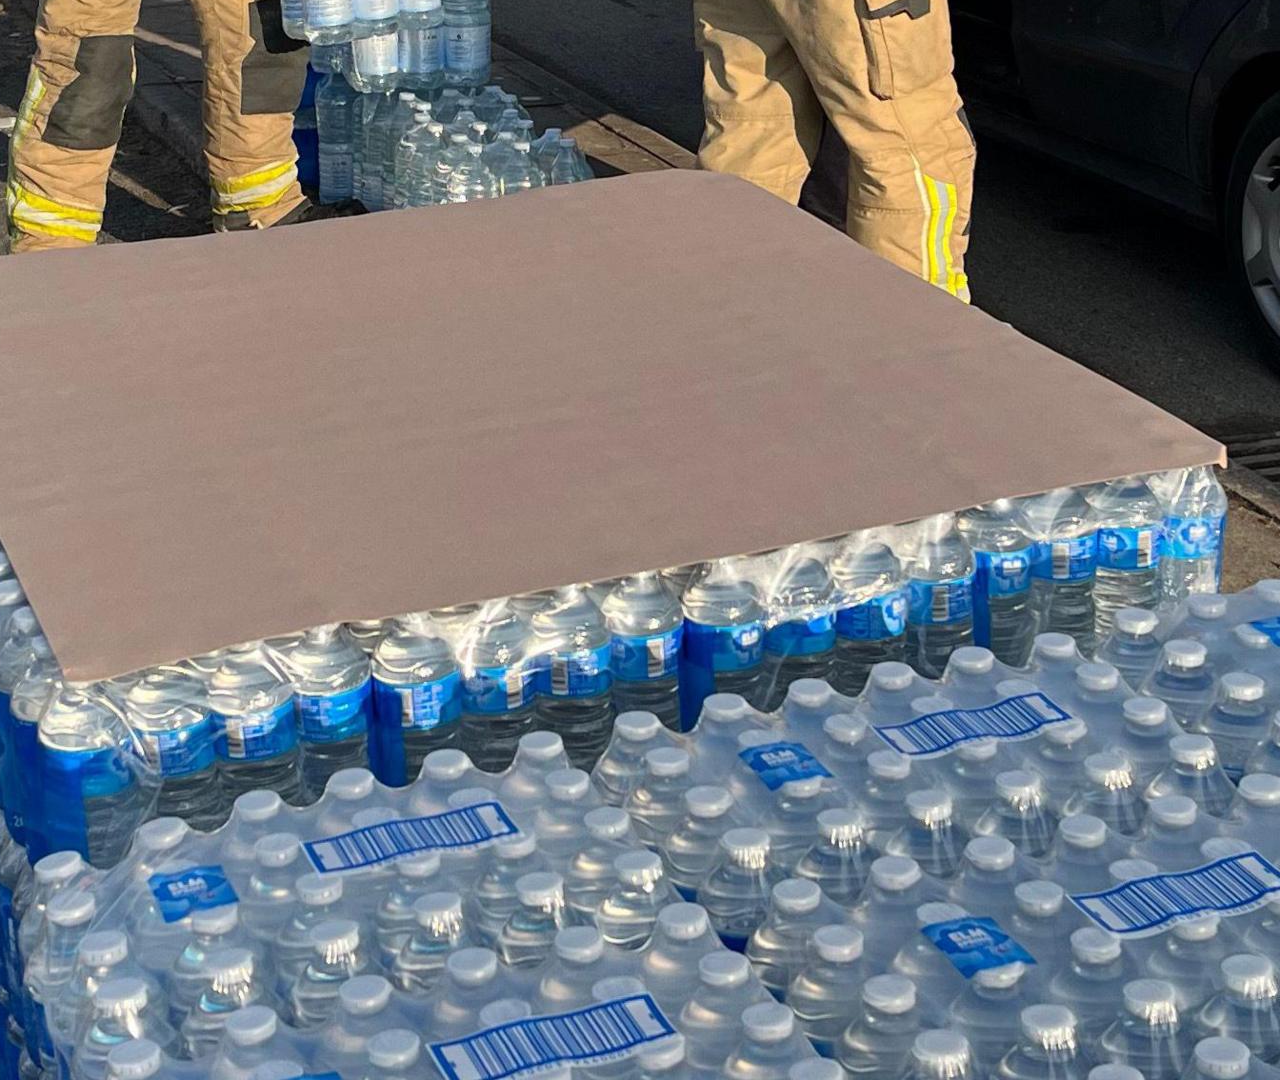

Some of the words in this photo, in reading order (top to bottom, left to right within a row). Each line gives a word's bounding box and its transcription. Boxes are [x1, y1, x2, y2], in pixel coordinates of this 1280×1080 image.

[761, 749, 797, 763] ELM
[167, 877, 207, 893] ELM
[947, 927, 989, 943] ELM
